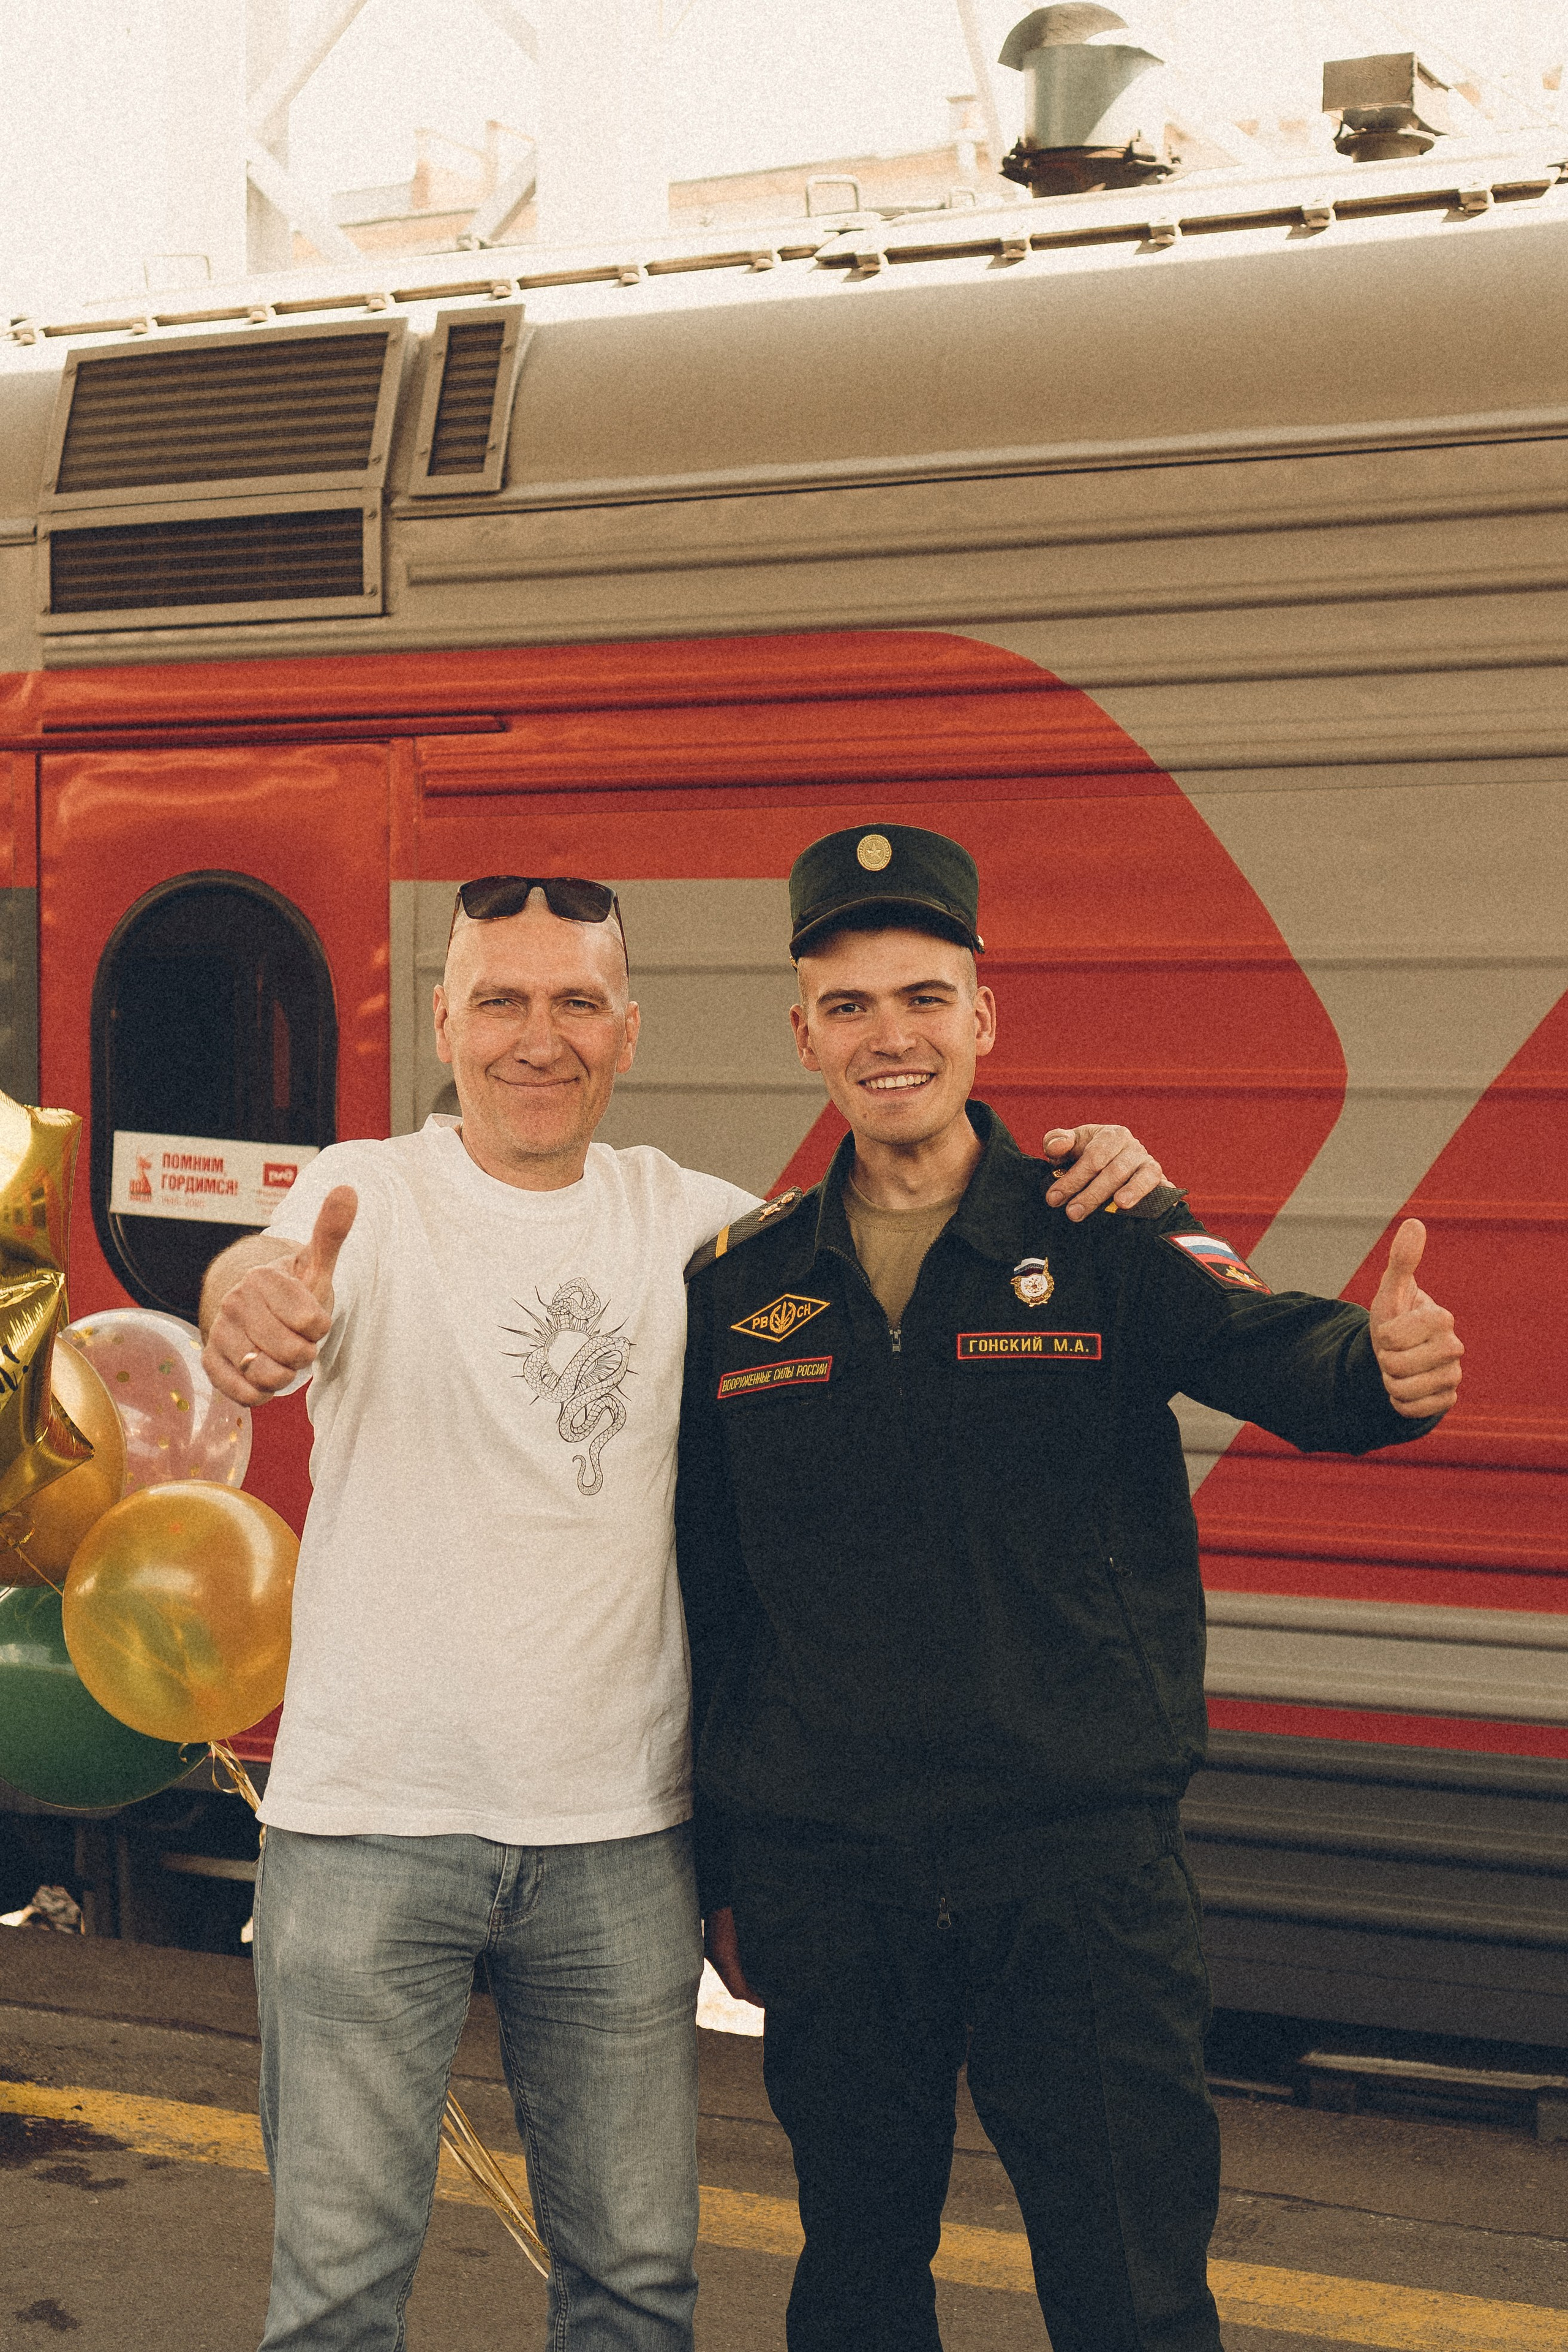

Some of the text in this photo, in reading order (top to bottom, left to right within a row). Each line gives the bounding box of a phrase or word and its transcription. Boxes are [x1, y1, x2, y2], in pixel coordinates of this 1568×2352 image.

[160, 1174, 238, 1196] ГОРДИМСЯ!
[752, 1303, 811, 1330] РВ СН
[969, 1336, 1090, 1352] ГОНСКИЙ М.А.
[722, 1363, 828, 1392] ВООРУЖЕННЫЕ СИЛЫ РОССИИ
